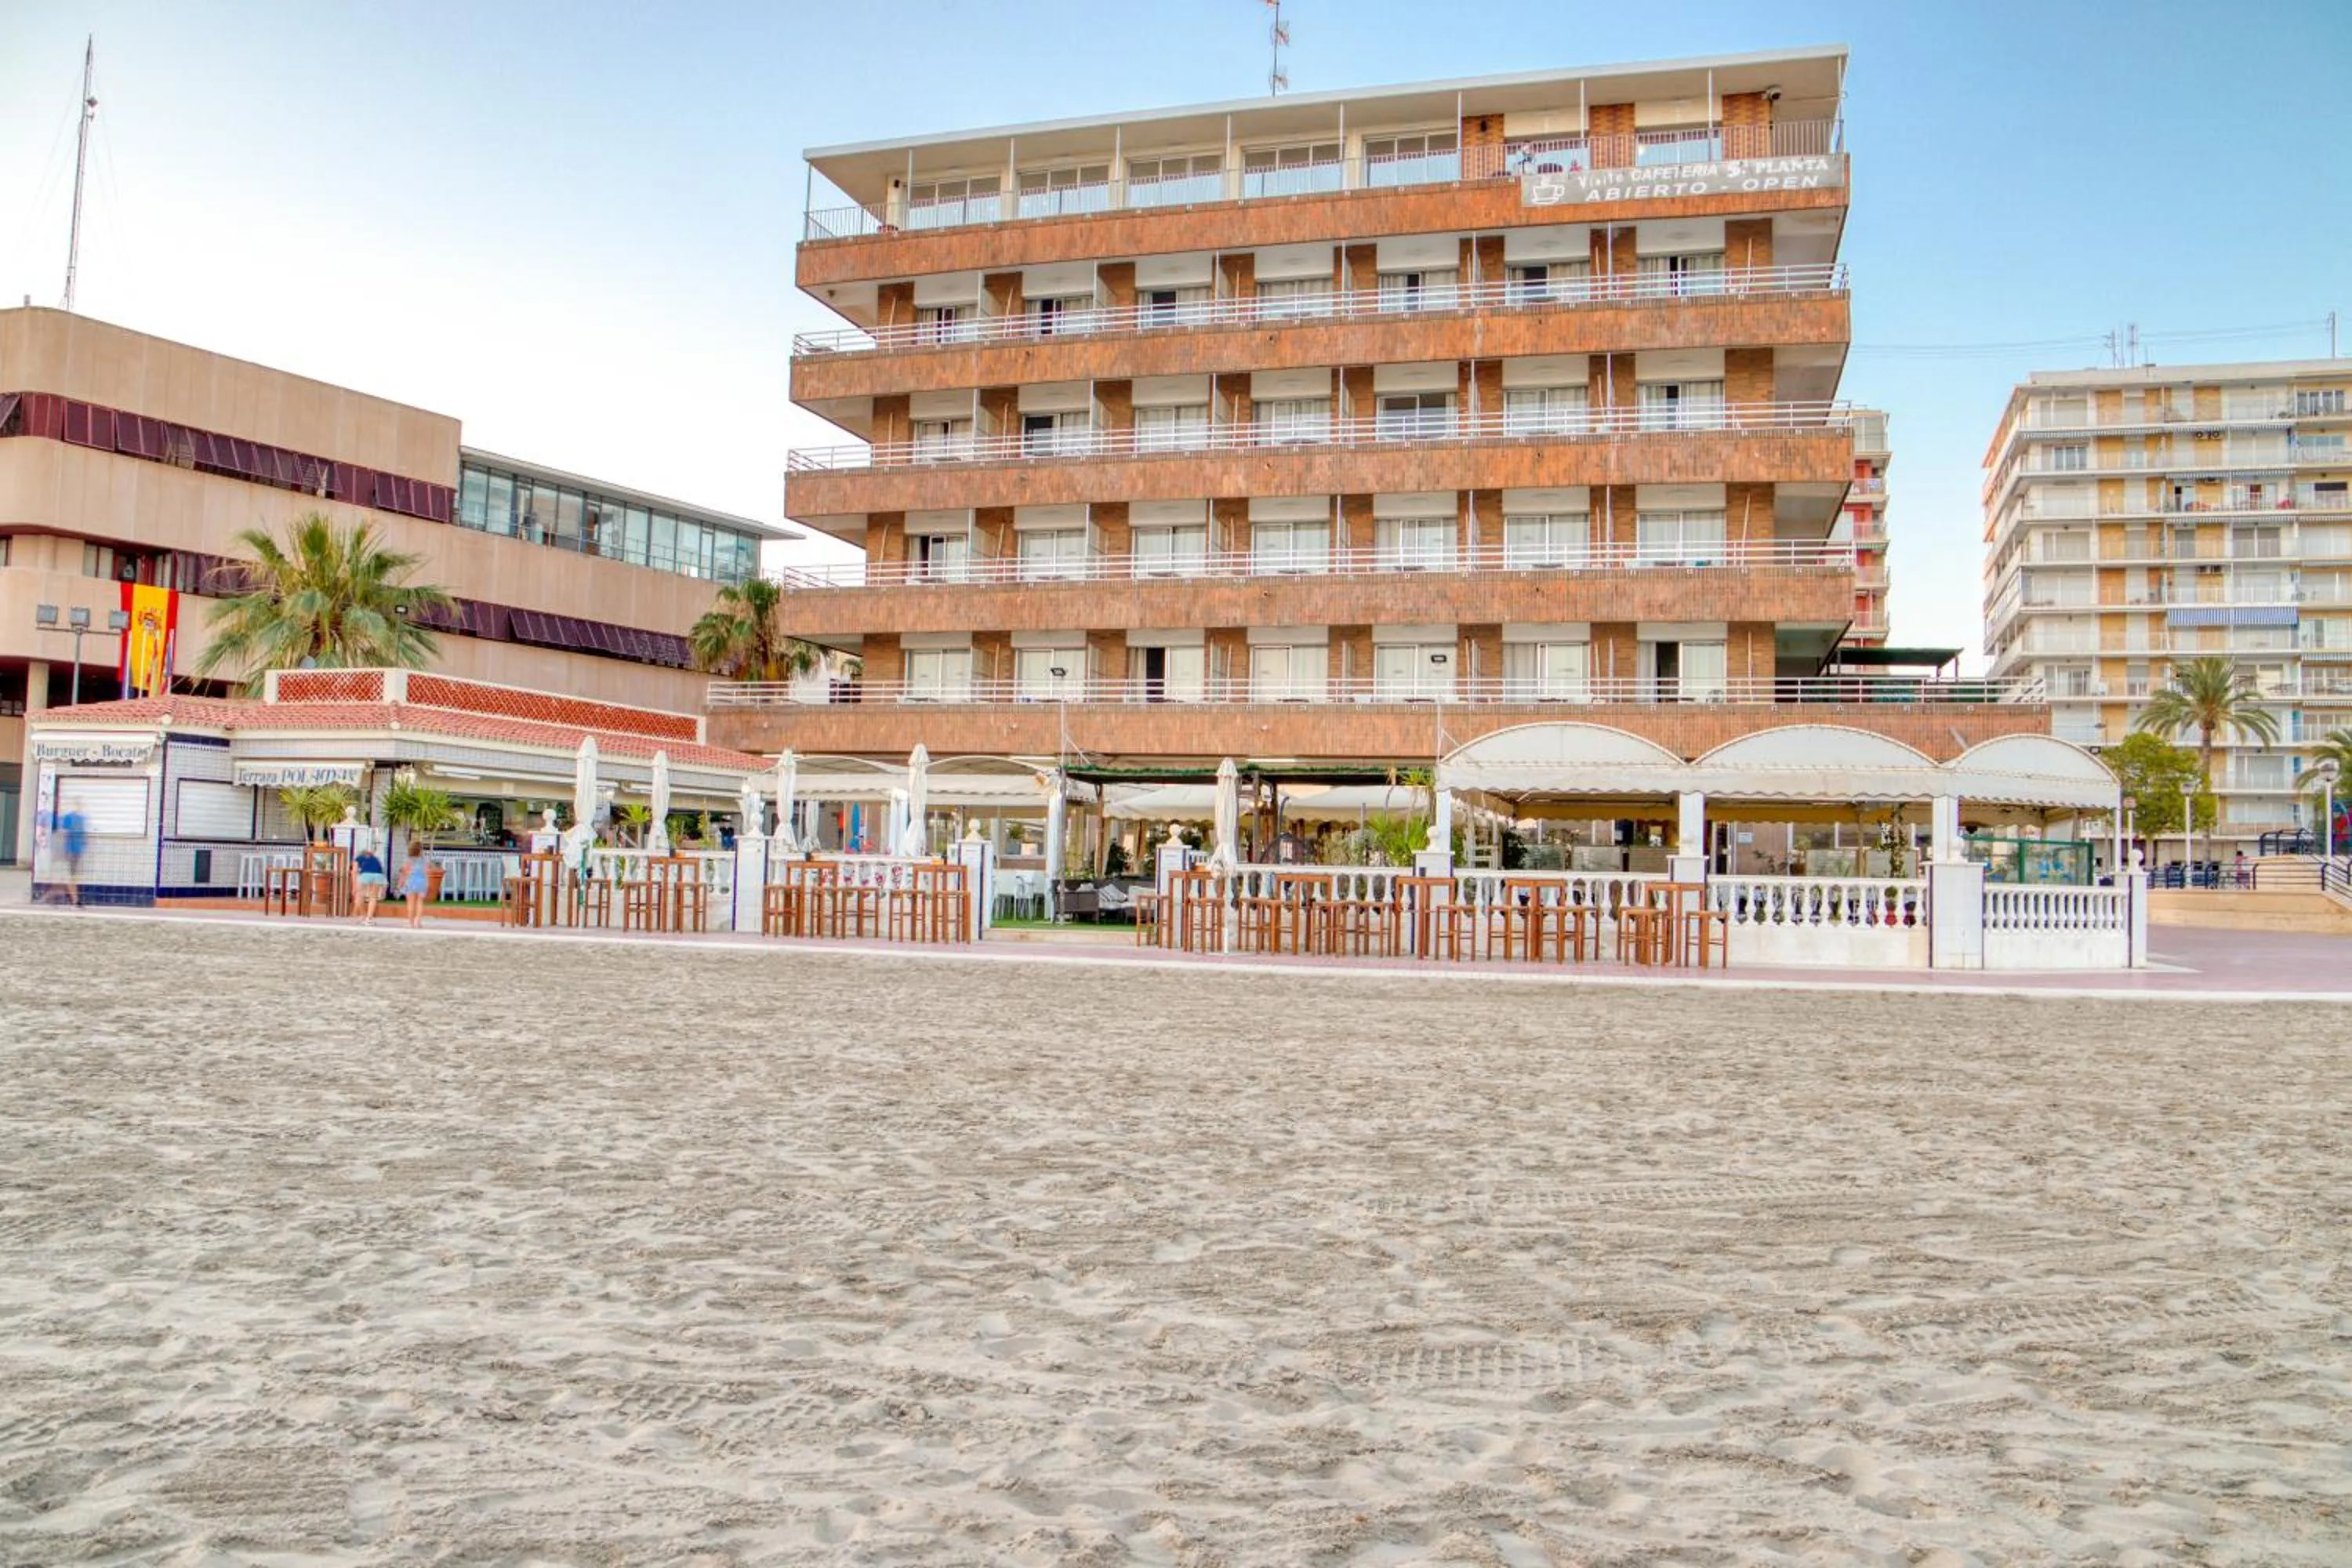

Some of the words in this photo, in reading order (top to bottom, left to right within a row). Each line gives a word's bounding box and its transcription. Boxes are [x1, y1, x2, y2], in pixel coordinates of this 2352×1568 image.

[1631, 164, 1718, 182] CAFETERIA
[1755, 159, 1828, 174] PLANTA
[1585, 182, 1707, 201] ABIERTO
[1743, 176, 1819, 191] OPEN
